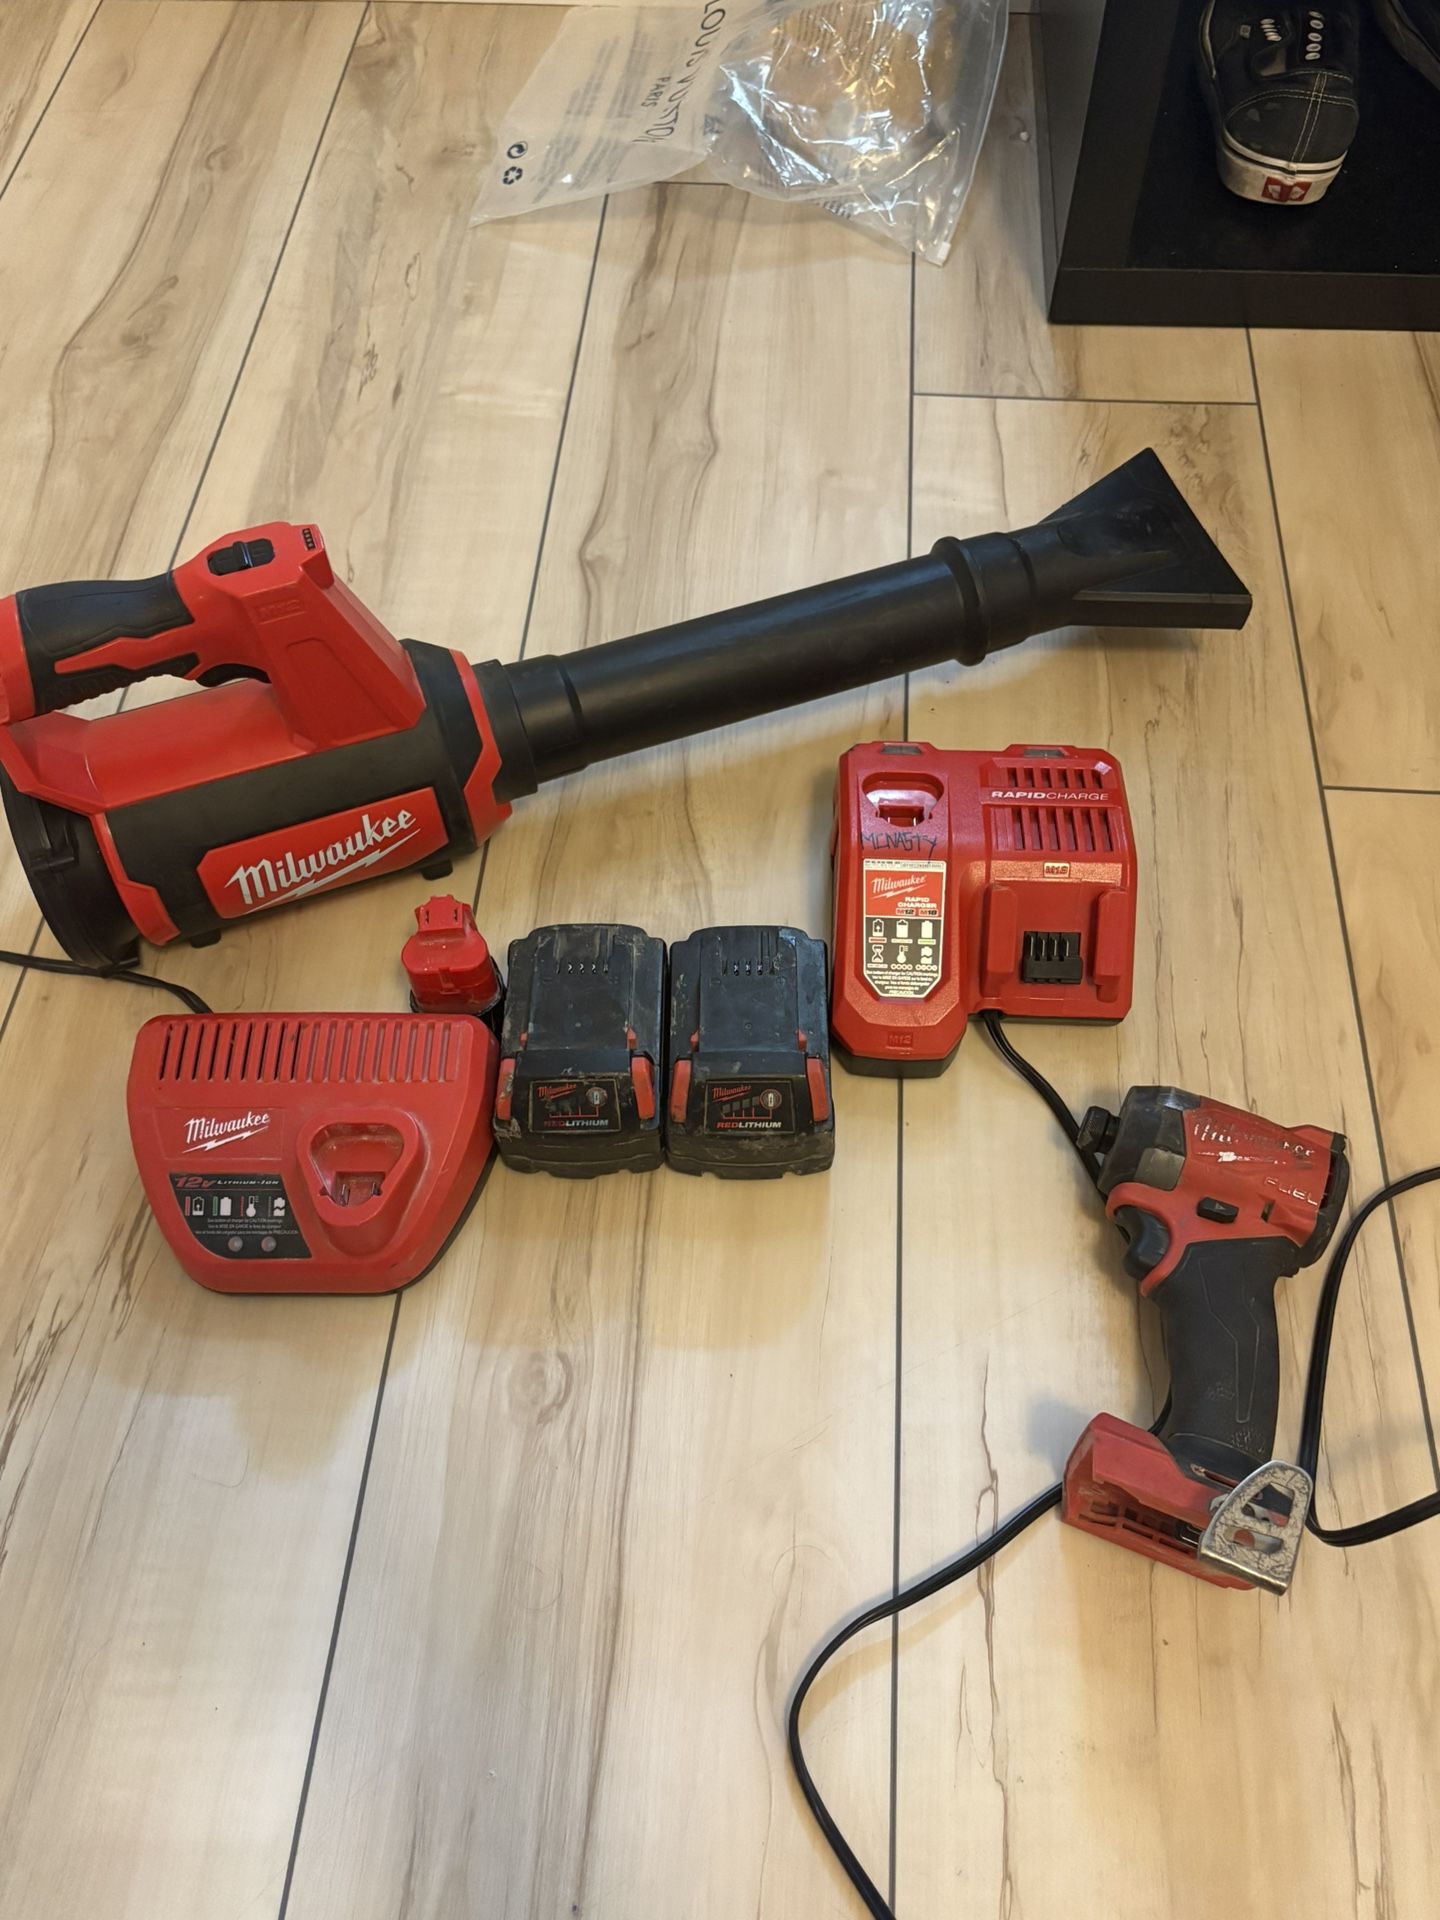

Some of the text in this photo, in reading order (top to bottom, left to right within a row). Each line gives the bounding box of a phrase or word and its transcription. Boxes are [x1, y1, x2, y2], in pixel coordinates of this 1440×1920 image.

[633, 66, 700, 143] VUTTO
[641, 76, 671, 107] PARIS
[224, 809, 418, 906] Milwaukee
[871, 875, 926, 893] Milwaukee
[712, 1084, 752, 1098] Milwaukee
[184, 1111, 270, 1143] Milwaukee
[1266, 1177, 1318, 1206] FUEL
